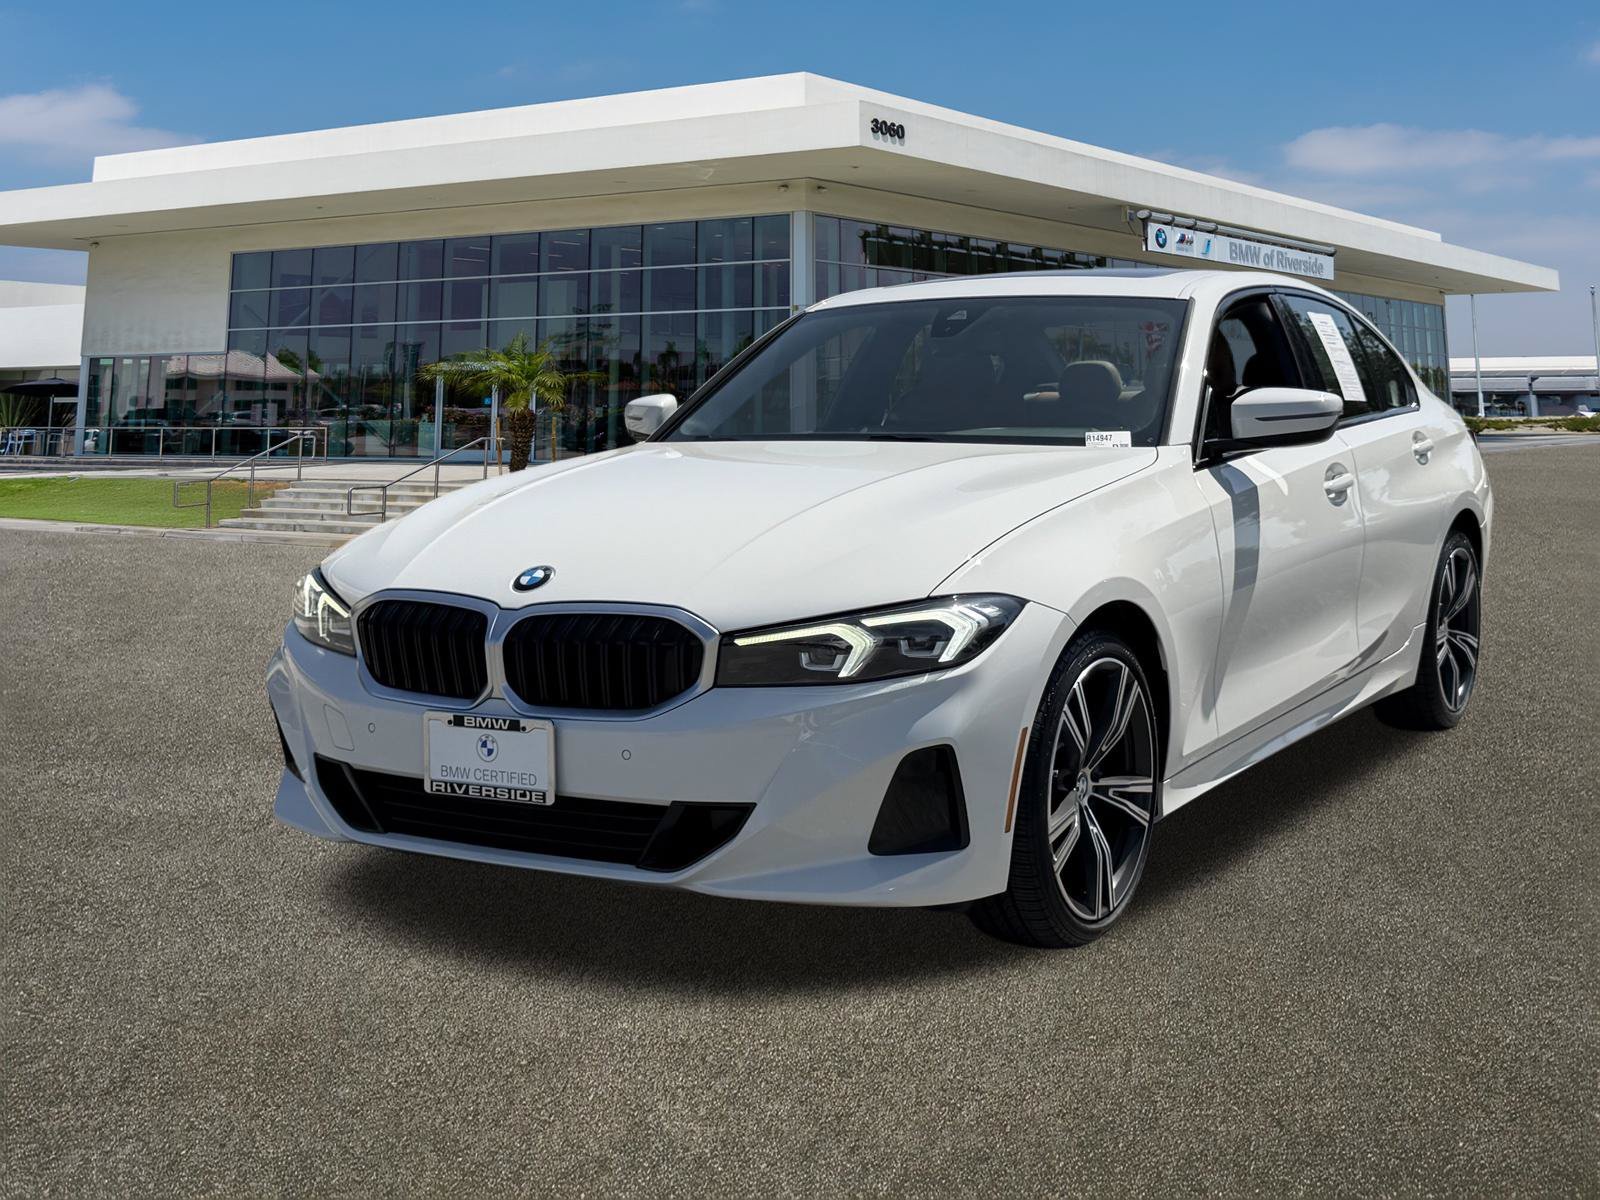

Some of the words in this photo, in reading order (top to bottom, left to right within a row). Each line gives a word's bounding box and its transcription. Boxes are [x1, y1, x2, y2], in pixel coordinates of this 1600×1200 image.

[870, 118, 905, 139] 3060
[1229, 241, 1260, 262] BMW
[1263, 249, 1275, 266] of
[1277, 250, 1324, 275] Riverside
[1086, 434, 1112, 442] R14947
[463, 716, 510, 730] BMW
[440, 765, 471, 780] BMW
[474, 767, 537, 786] CERTIFIED
[432, 781, 545, 803] RIVERSIDE
